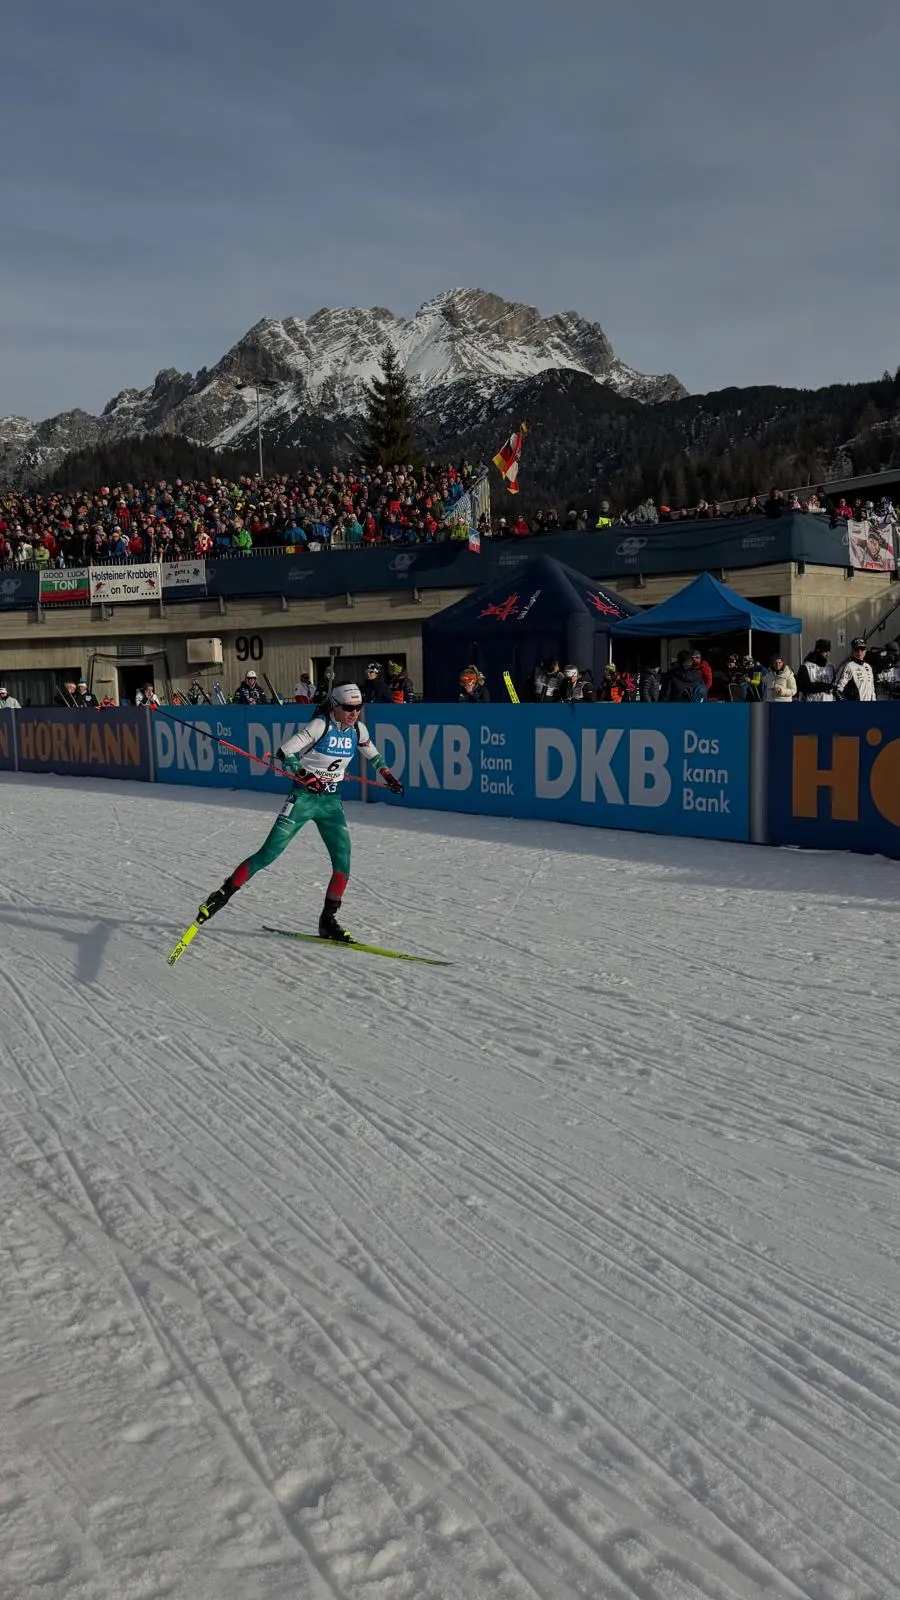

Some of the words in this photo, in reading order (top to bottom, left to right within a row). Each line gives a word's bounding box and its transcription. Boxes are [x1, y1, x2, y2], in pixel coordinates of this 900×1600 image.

[43, 571, 64, 579] GOOD
[67, 570, 86, 578] LUCK
[52, 580, 78, 590] TONI
[91, 571, 126, 581] Holsteiner
[127, 569, 158, 579] Krabben
[110, 587, 121, 595] on
[123, 585, 140, 594] Tour
[235, 635, 264, 661] 90
[216, 721, 232, 737] Das
[480, 725, 506, 746] Das
[20, 716, 141, 767] HÖRMANN
[154, 719, 215, 772] DKB
[328, 736, 353, 749] DKB
[683, 729, 720, 755] Das
[217, 758, 239, 775] Bank
[326, 758, 343, 772] 6
[373, 722, 473, 791] DKB
[480, 750, 513, 771] kann
[534, 727, 672, 808] DKB
[682, 758, 729, 784] kann
[480, 775, 515, 796] Bank
[682, 787, 731, 814] Bank
